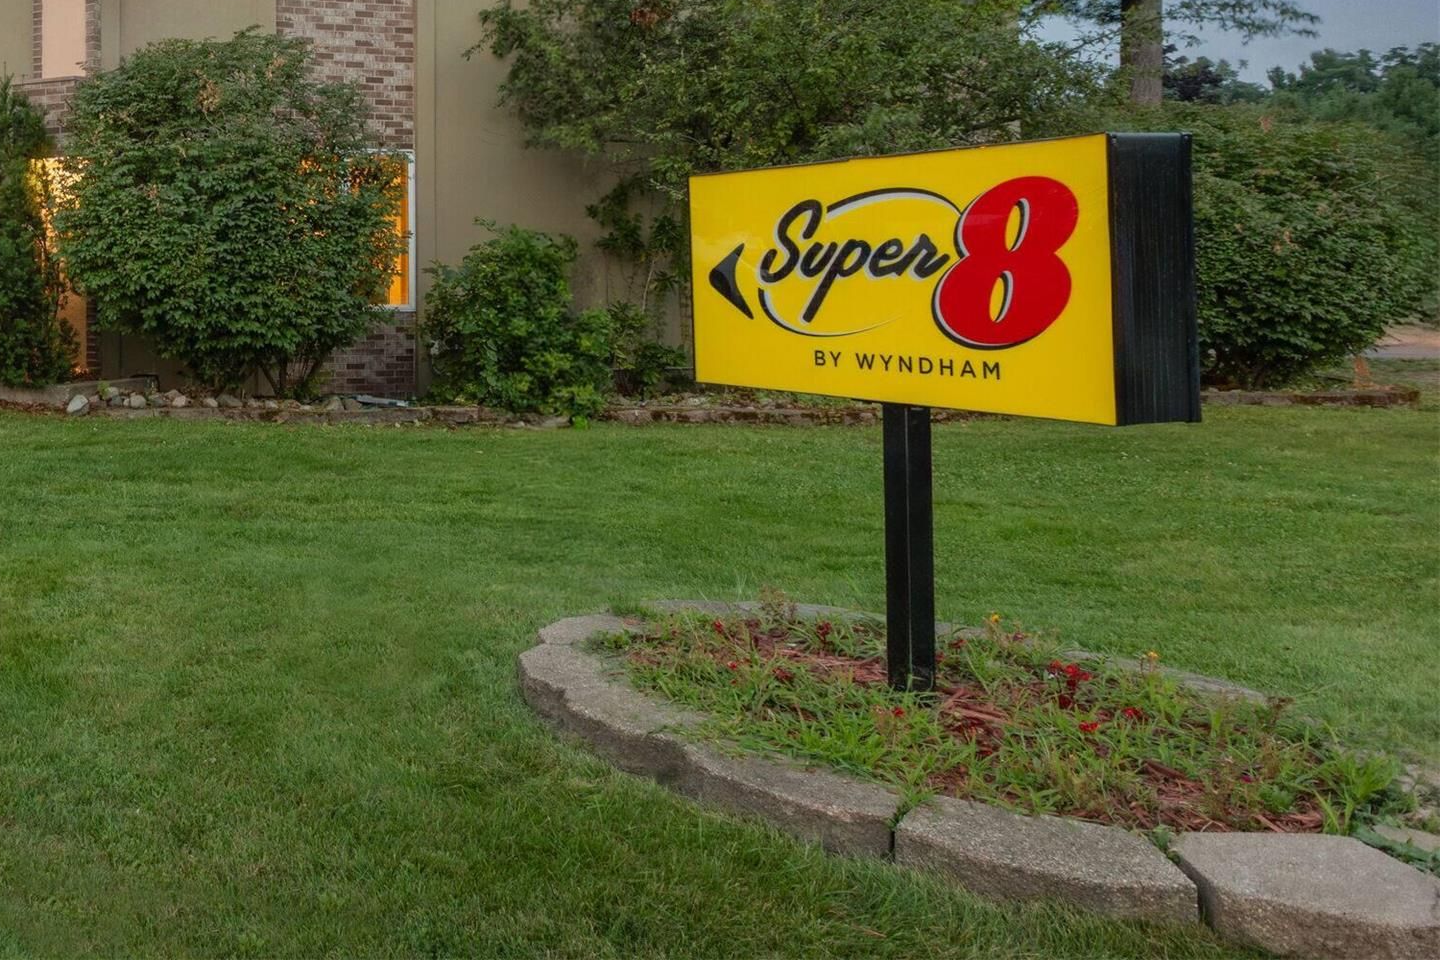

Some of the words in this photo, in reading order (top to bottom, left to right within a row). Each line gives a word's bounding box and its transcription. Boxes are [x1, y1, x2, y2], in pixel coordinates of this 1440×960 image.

[758, 198, 951, 324] Super
[931, 175, 1080, 351] 8
[814, 350, 842, 368] BY
[855, 352, 1001, 381] WYNDHAM
